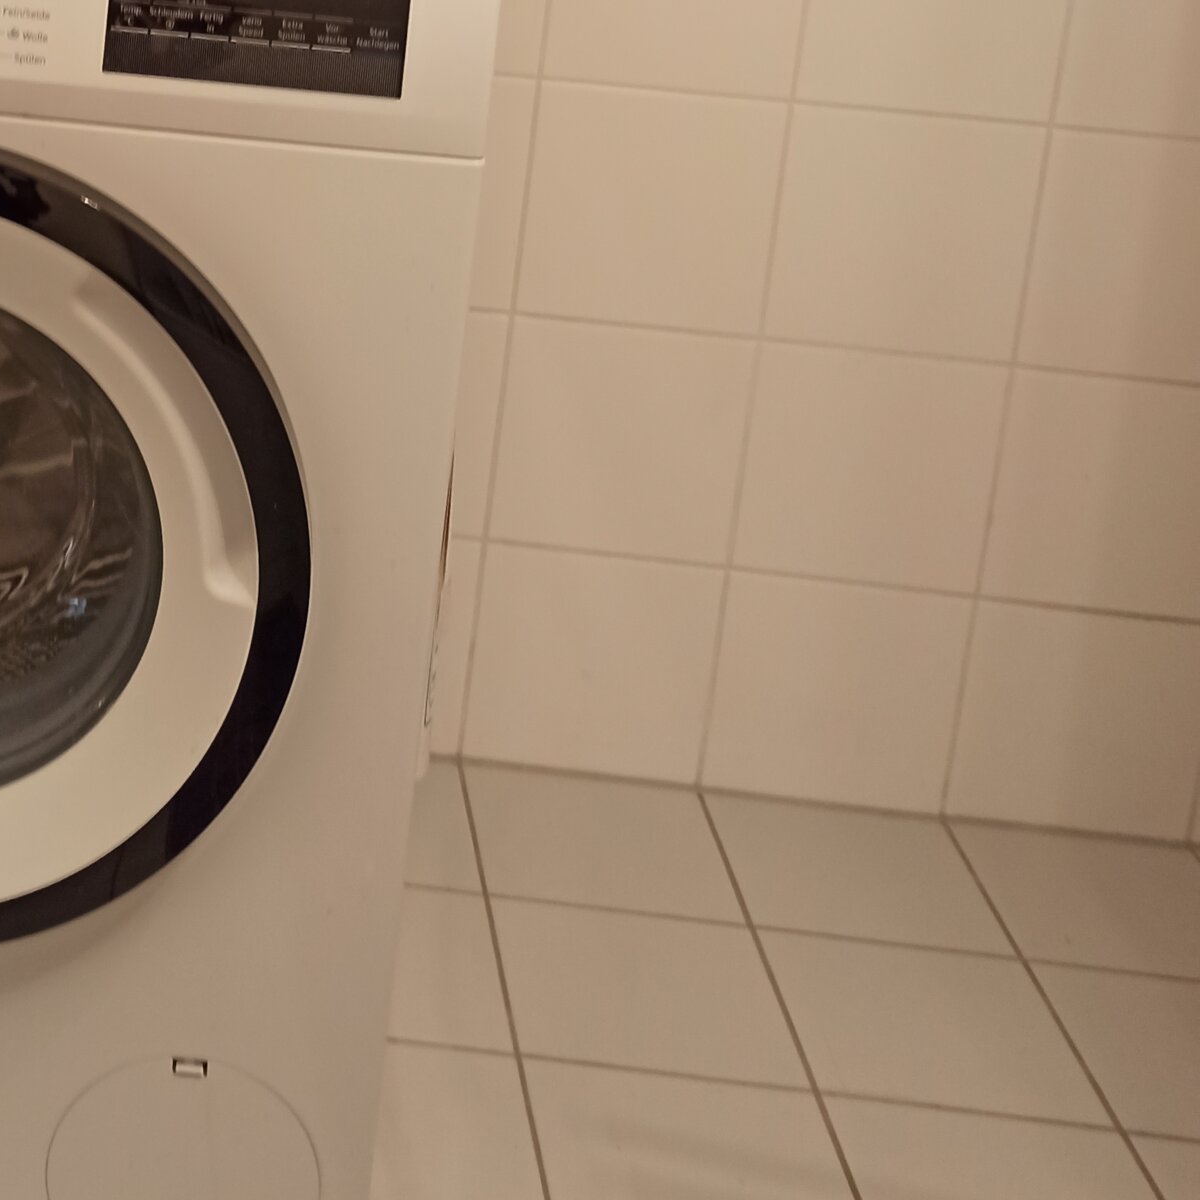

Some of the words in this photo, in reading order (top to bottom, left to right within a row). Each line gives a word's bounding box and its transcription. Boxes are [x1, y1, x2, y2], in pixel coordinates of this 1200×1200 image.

[3, 5, 50, 20] Fein/Seide
[22, 30, 49, 42] Wolle
[369, 26, 389, 38] Start
[14, 52, 47, 67] Spülen
